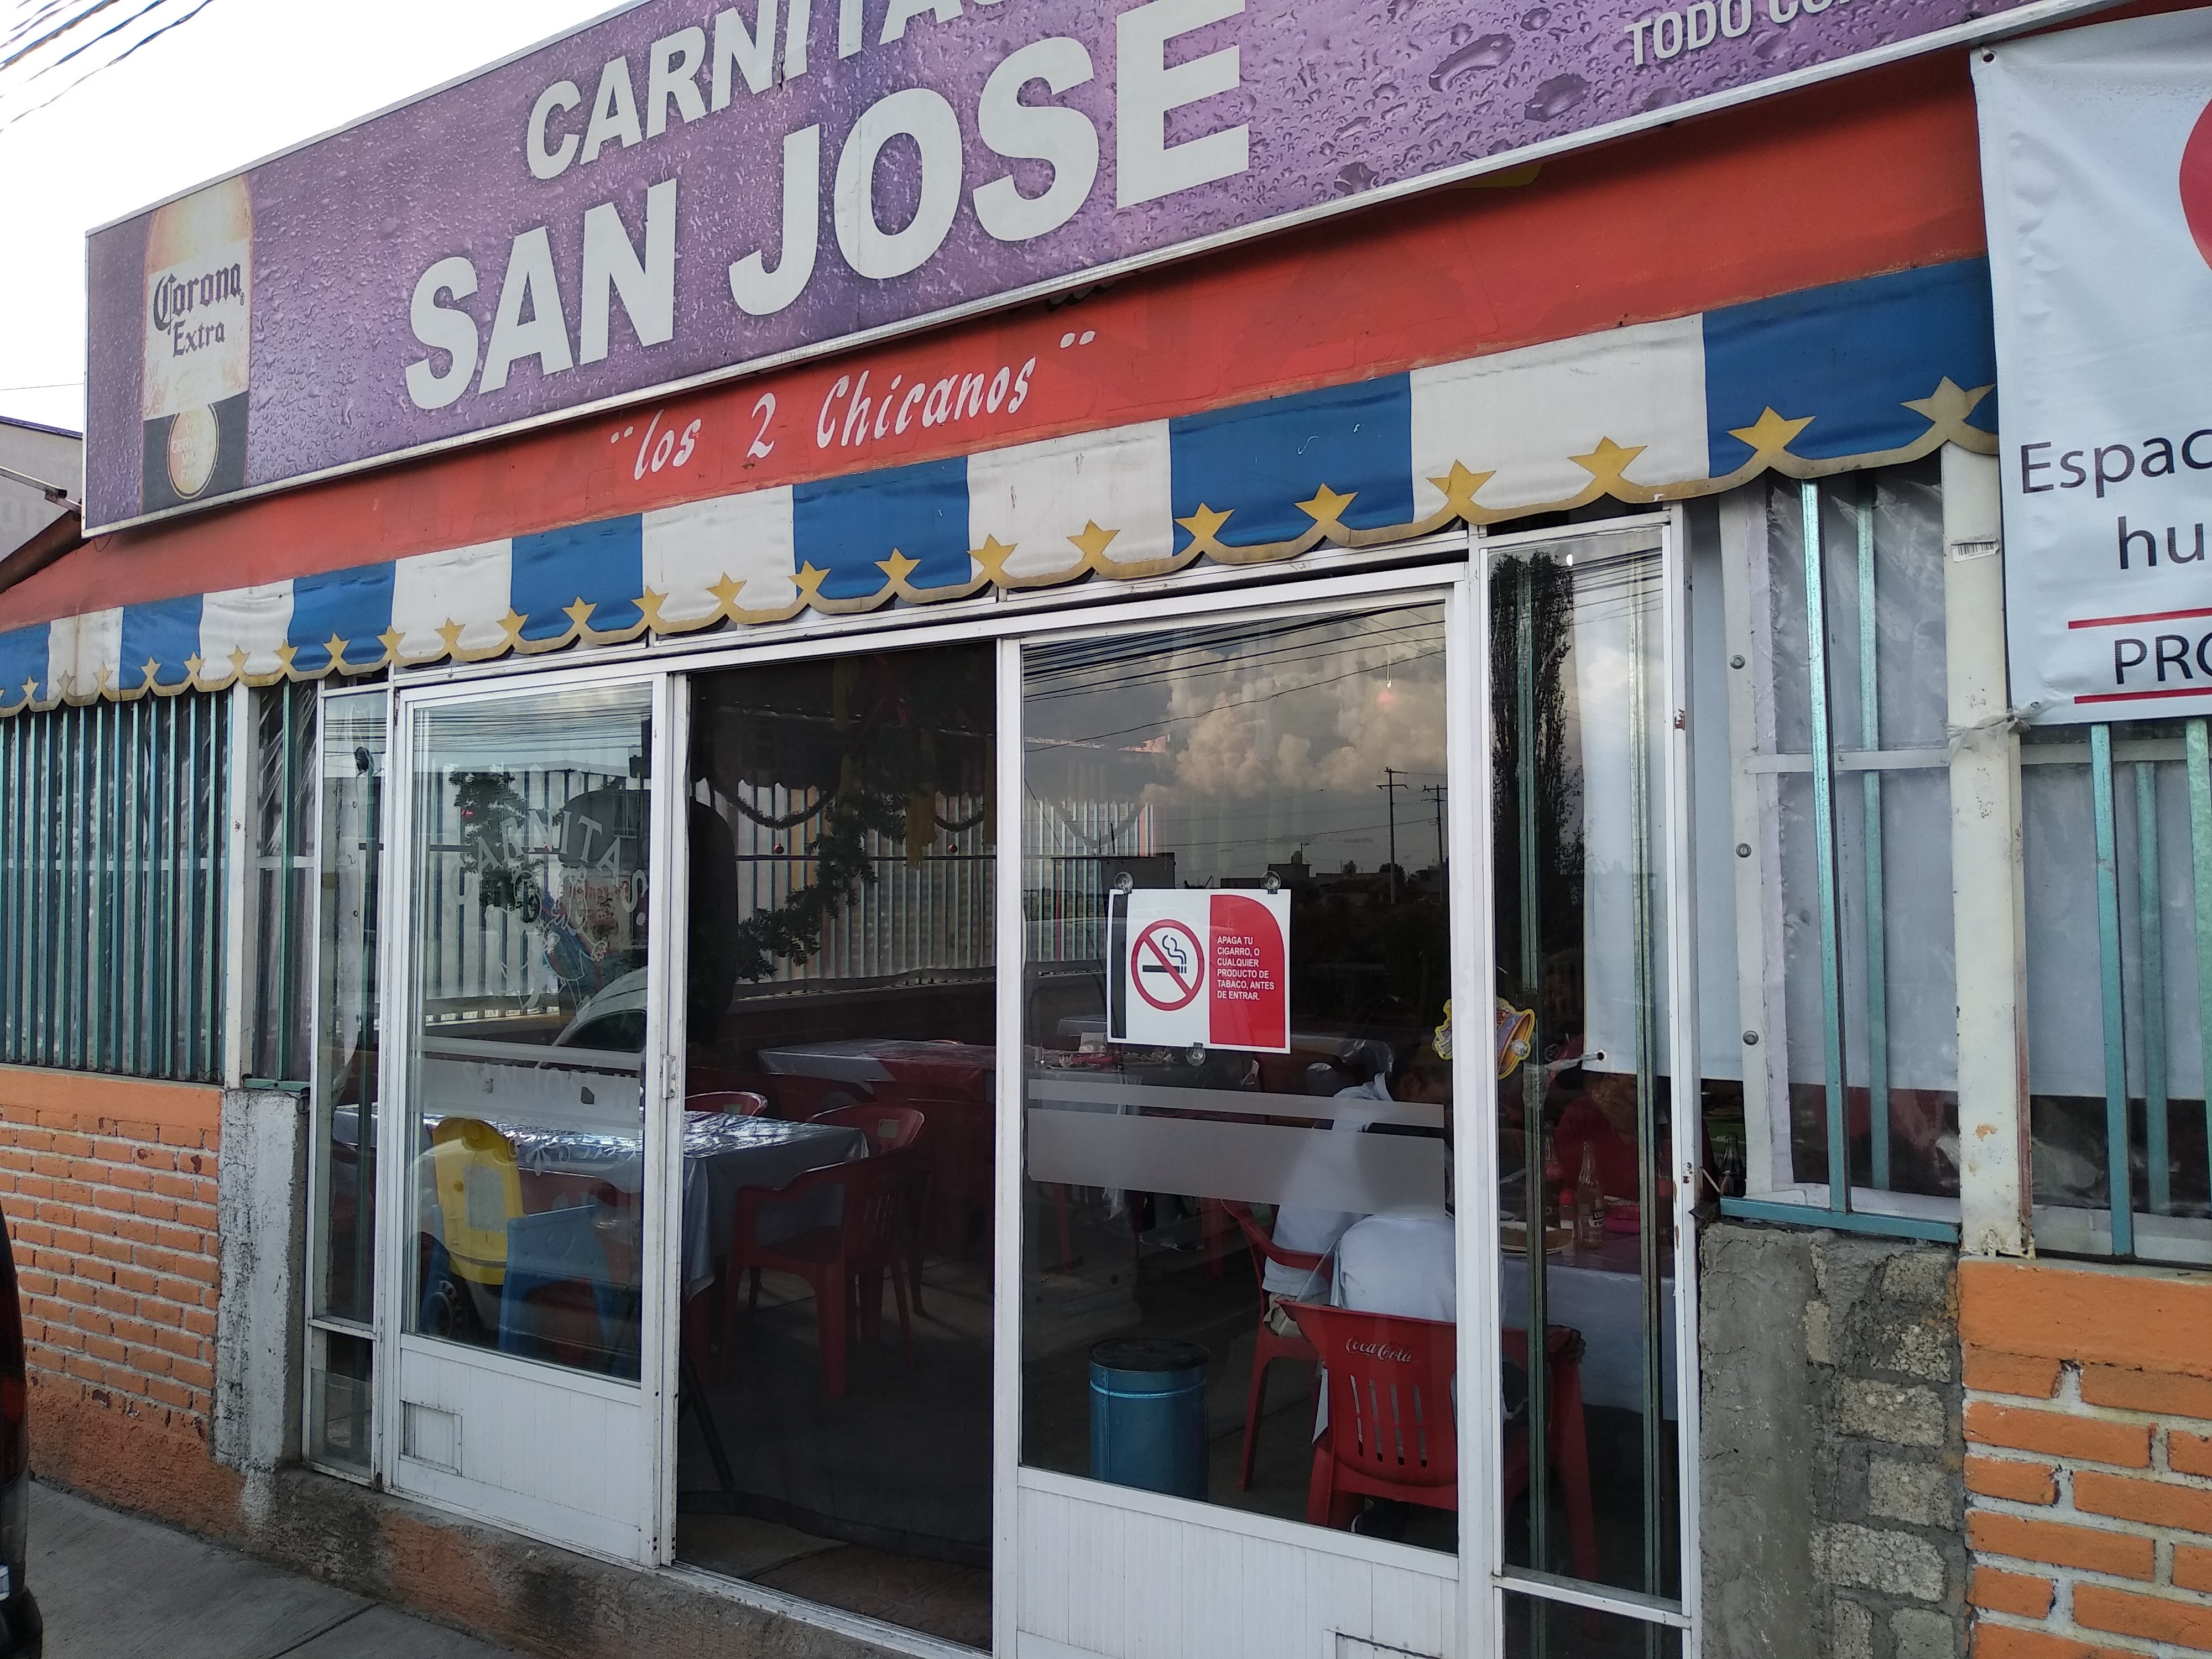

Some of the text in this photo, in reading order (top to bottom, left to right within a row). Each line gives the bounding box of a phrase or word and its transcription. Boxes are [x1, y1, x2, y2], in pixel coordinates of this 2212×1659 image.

[1624, 0, 1751, 66] TODO
[526, 0, 1002, 180] CARNI
[405, 0, 1249, 410] SAN JOSE
[153, 263, 242, 336] Corona
[173, 320, 226, 357] Extra
[746, 393, 776, 459] 2
[2117, 515, 2205, 570] hu
[1217, 936, 1253, 945] APAGA TU
[1217, 947, 1260, 957] CIGARRO, O
[1217, 958, 1259, 967] CUALQUIER
[1217, 969, 1269, 979] PRODUCTO DE
[1217, 979, 1275, 990] TABACO, ANTES
[1217, 990, 1260, 1000] DE ENTRAR.
